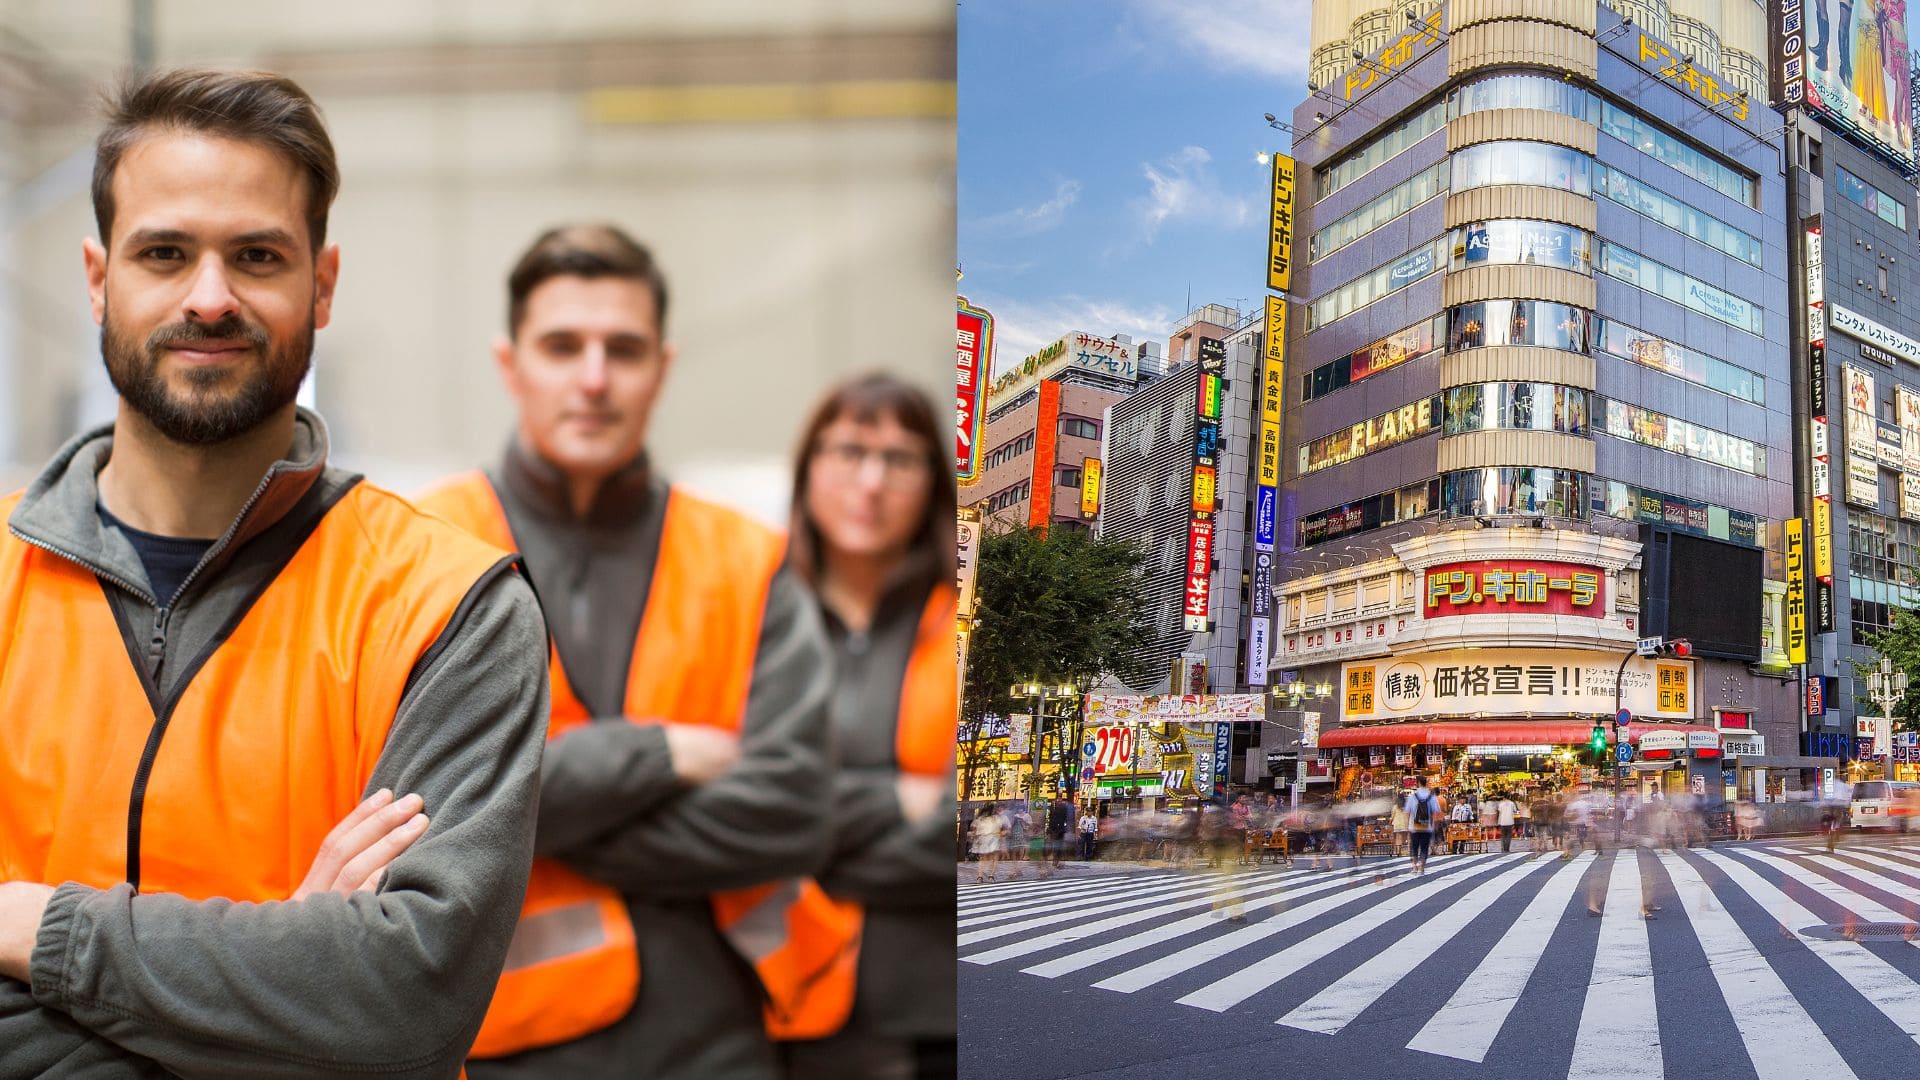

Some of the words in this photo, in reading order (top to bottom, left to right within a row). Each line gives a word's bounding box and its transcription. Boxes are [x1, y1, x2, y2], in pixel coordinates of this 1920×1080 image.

[1269, 302, 1283, 358] ブランド品
[1835, 310, 1866, 332] エンタメ
[1868, 324, 1920, 356] レストランタワ
[1075, 350, 1136, 375] カプセル
[1266, 370, 1280, 413] 貴金属
[1351, 397, 1430, 448] FLARE
[1262, 429, 1276, 480] 高額買取
[1667, 417, 1753, 472] FLARE
[1641, 496, 1662, 514] 販売
[1385, 672, 1421, 699] 情熱
[1433, 664, 1581, 698] 価格宣言!!
[1659, 669, 1686, 686] 情熱
[1348, 693, 1373, 710] 価格
[1659, 690, 1686, 709] 価格
[1095, 727, 1132, 775] 270
[1159, 741, 1182, 753] カラオケ
[1214, 724, 1229, 773] カラオケ
[1162, 769, 1185, 789] 747
[1199, 752, 1210, 793] カラオケ
[1215, 774, 1225, 783] B1
[1825, 770, 1832, 779] P
